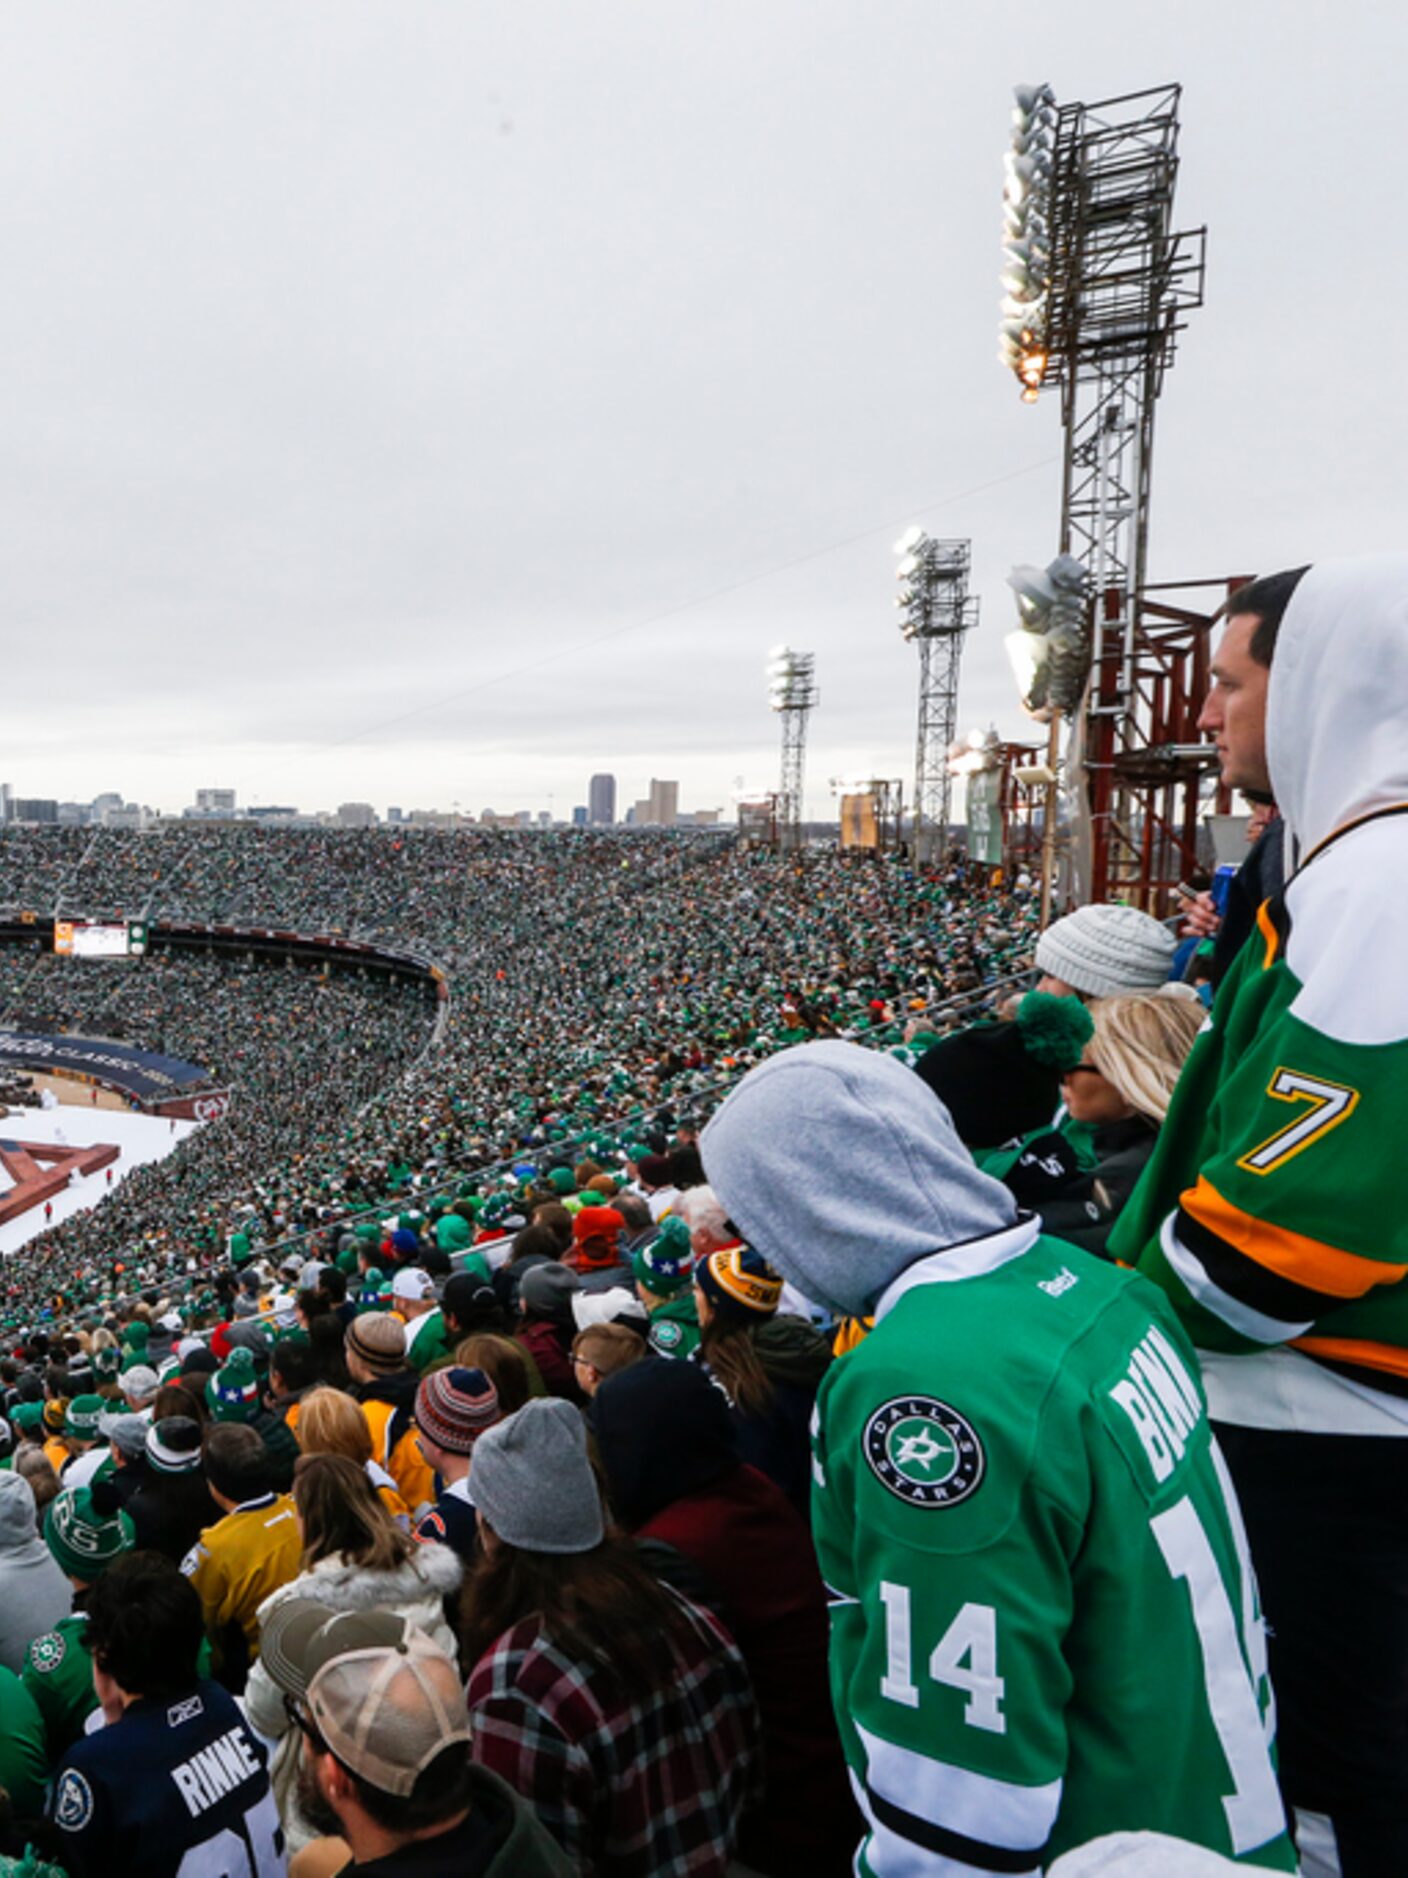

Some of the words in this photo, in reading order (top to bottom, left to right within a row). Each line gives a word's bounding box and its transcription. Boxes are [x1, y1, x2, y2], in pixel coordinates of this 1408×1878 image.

[1236, 1066, 1361, 1176] 7
[874, 1403, 974, 1453] DALLAS
[878, 1459, 967, 1500] STARS
[880, 1580, 1006, 1734] 14
[171, 1726, 261, 1818] RINNE
